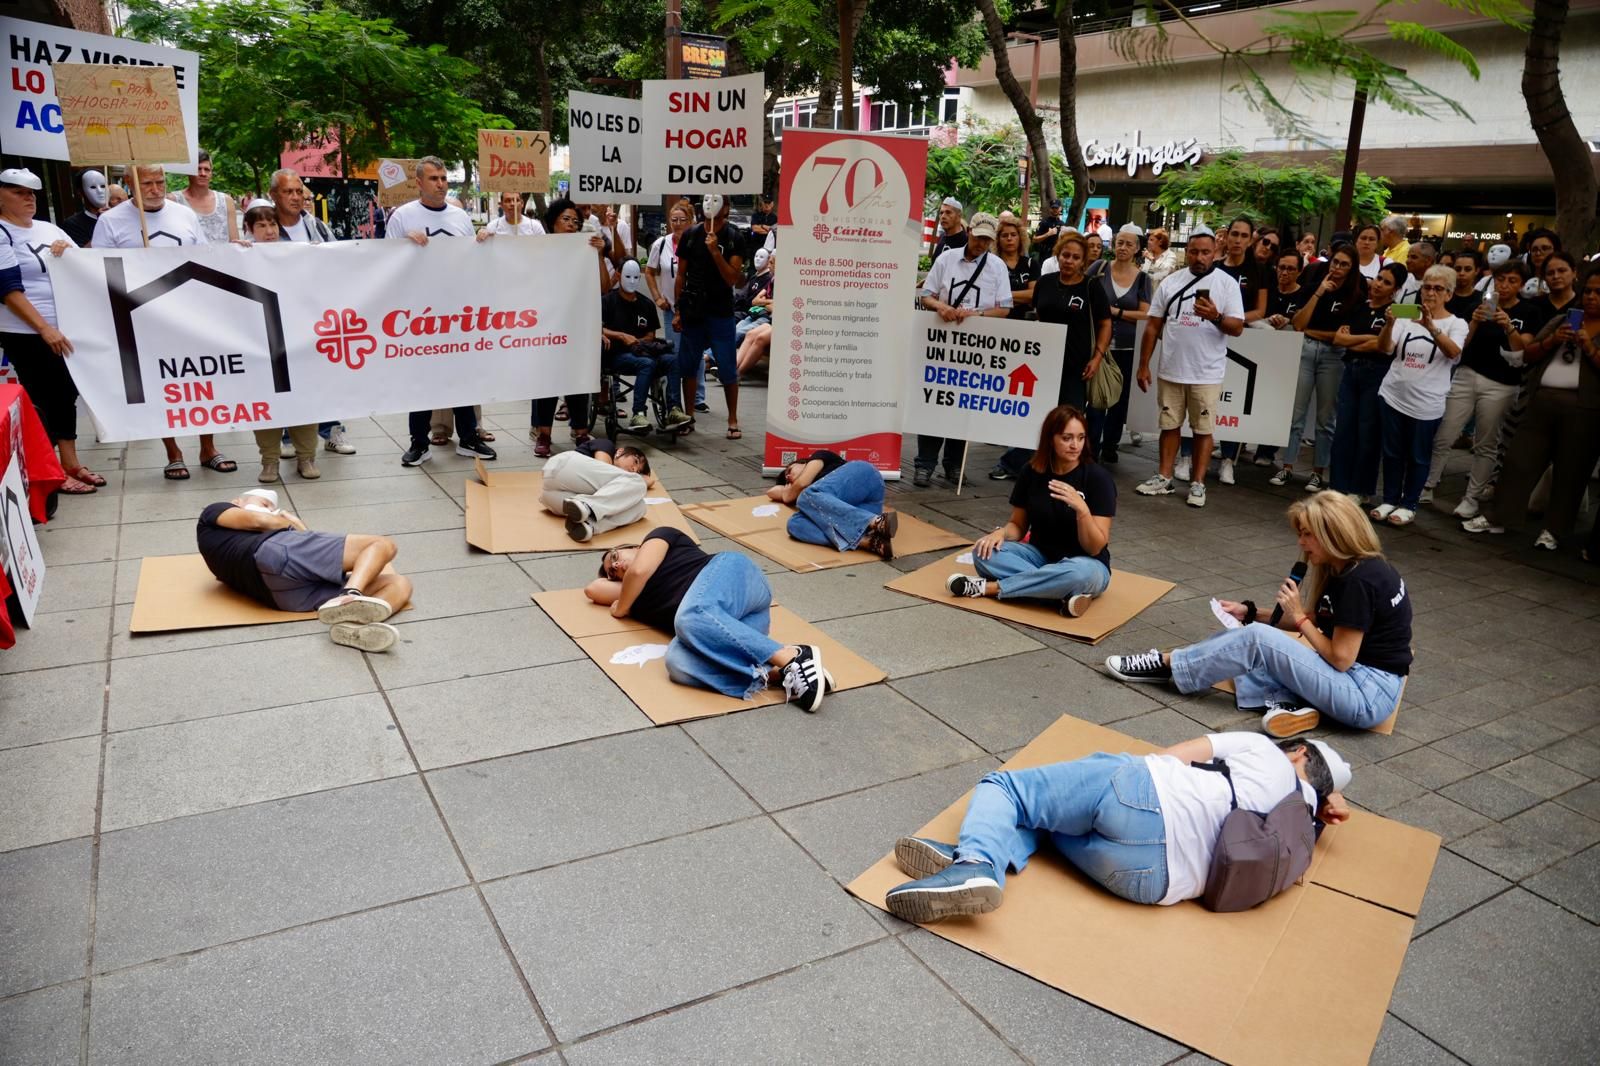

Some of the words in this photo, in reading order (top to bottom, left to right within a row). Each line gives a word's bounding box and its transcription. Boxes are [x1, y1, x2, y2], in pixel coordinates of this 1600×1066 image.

[9, 34, 72, 66] HAZ
[682, 45, 726, 67] BRESH
[11, 67, 45, 94] LO
[73, 95, 129, 110] HOGAR
[669, 92, 710, 113] SIN
[717, 88, 745, 112] UN
[16, 100, 64, 134] AC
[570, 108, 593, 129] NO
[597, 113, 623, 133] LES
[628, 117, 642, 135] D
[665, 127, 747, 149] HOGAR
[489, 153, 536, 177] DIGNA
[602, 145, 622, 164] LA
[668, 164, 743, 184] DIGNO
[812, 156, 884, 215] 70
[833, 225, 884, 238] Cáritas
[1447, 231, 1479, 240] MICHL
[1480, 232, 1502, 240] KORS
[793, 257, 813, 266] Más
[815, 257, 827, 266] de
[829, 258, 854, 268] 8.500
[855, 261, 898, 270] personas
[799, 268, 872, 279] comprometidas
[873, 272, 891, 280] con
[800, 279, 841, 288] nuestros
[843, 280, 889, 290] proyectos
[806, 298, 842, 307] Personas
[843, 299, 855, 307] sin
[856, 301, 878, 310] hogar
[382, 305, 538, 338] Cáritas
[806, 313, 841, 321] Personas
[842, 314, 880, 323] migrantes
[805, 328, 834, 337] Empleo
[841, 329, 879, 338] formación
[927, 328, 947, 343] UN
[951, 331, 996, 350] TECHO
[1000, 337, 1021, 353] NO
[1024, 341, 1041, 356] ES
[384, 341, 470, 359] Diocesana
[474, 336, 493, 351] de
[499, 333, 568, 349] Canarias
[804, 342, 826, 351] Mujer
[833, 343, 858, 351] familia
[159, 353, 245, 379] NADIE
[804, 355, 833, 363] Infancia
[840, 357, 872, 365] mayores
[926, 346, 945, 361] UN
[949, 349, 986, 369] LUJO,
[990, 355, 1006, 370] ES
[803, 369, 848, 379] Prostitución
[855, 371, 872, 379] trata
[924, 365, 1006, 392] DERECHO
[164, 381, 214, 404] SIN
[802, 385, 844, 393] Adicciones
[801, 398, 850, 408] Cooperación
[851, 400, 898, 409] Internacional
[923, 388, 933, 404] Y
[936, 390, 955, 406] ES
[958, 393, 1030, 417] REFUGIO
[166, 401, 272, 429] HOGAR
[801, 411, 848, 420] Voluntariado
